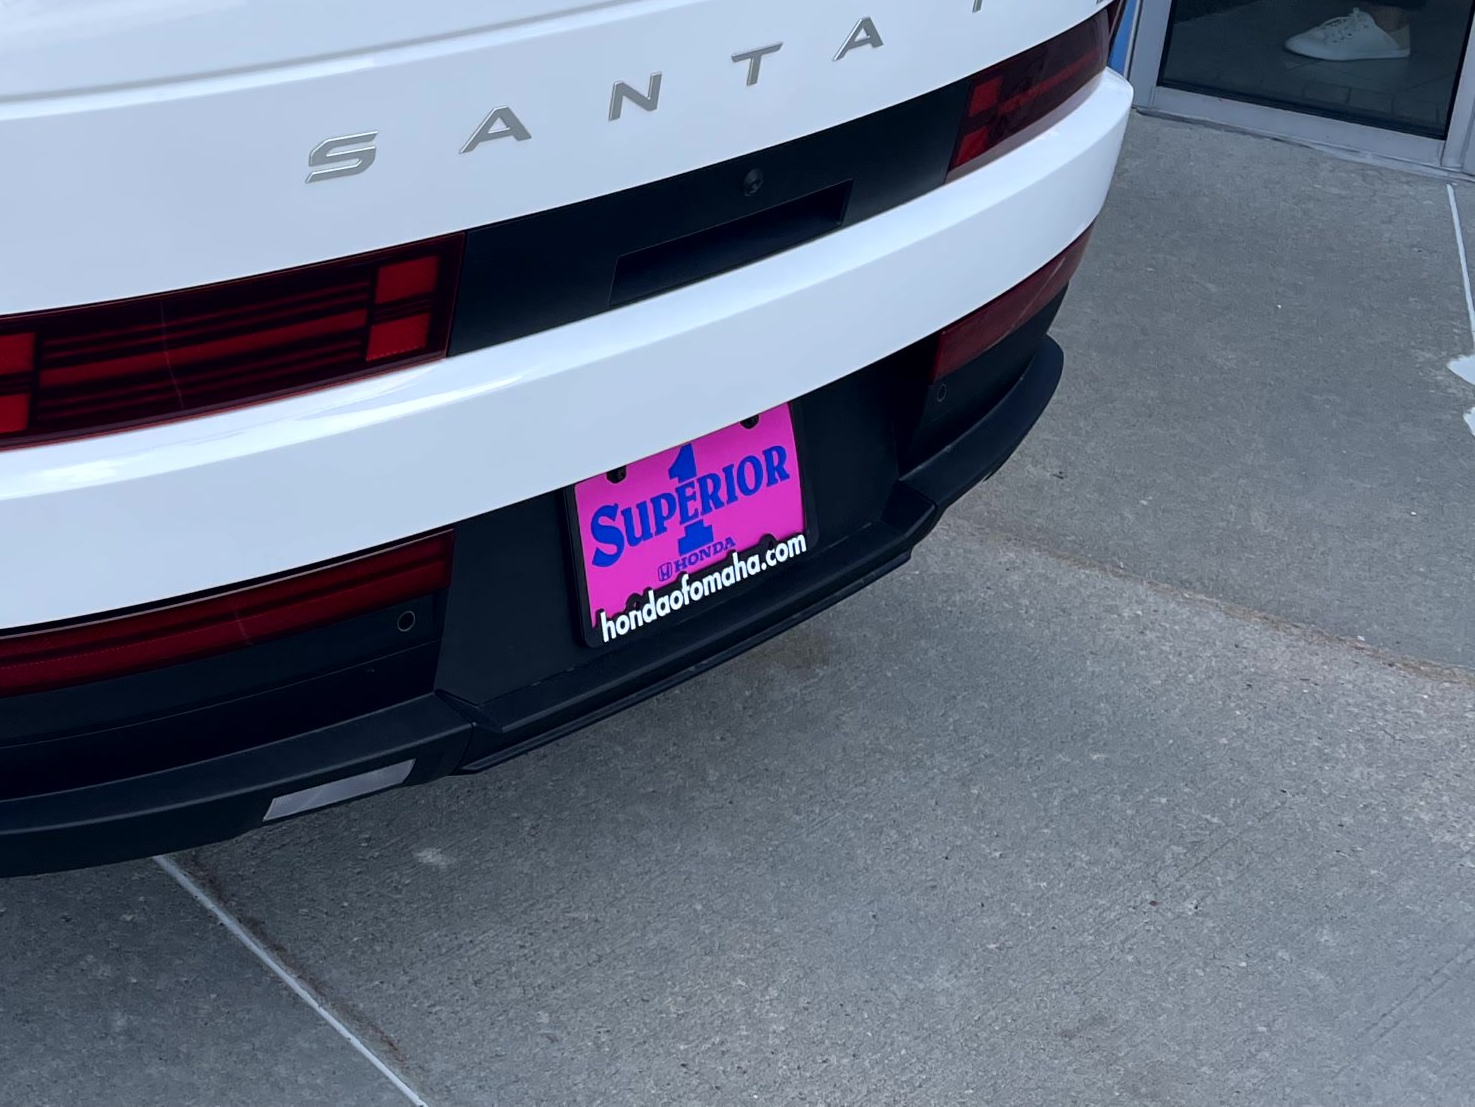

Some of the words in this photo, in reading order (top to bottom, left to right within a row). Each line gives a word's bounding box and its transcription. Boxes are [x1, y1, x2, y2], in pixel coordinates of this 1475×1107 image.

[304, 15, 887, 184] SANTA
[590, 445, 791, 568] SUPERIOR
[674, 536, 736, 573] HONDA
[600, 534, 807, 643] hondaofomaha.com
